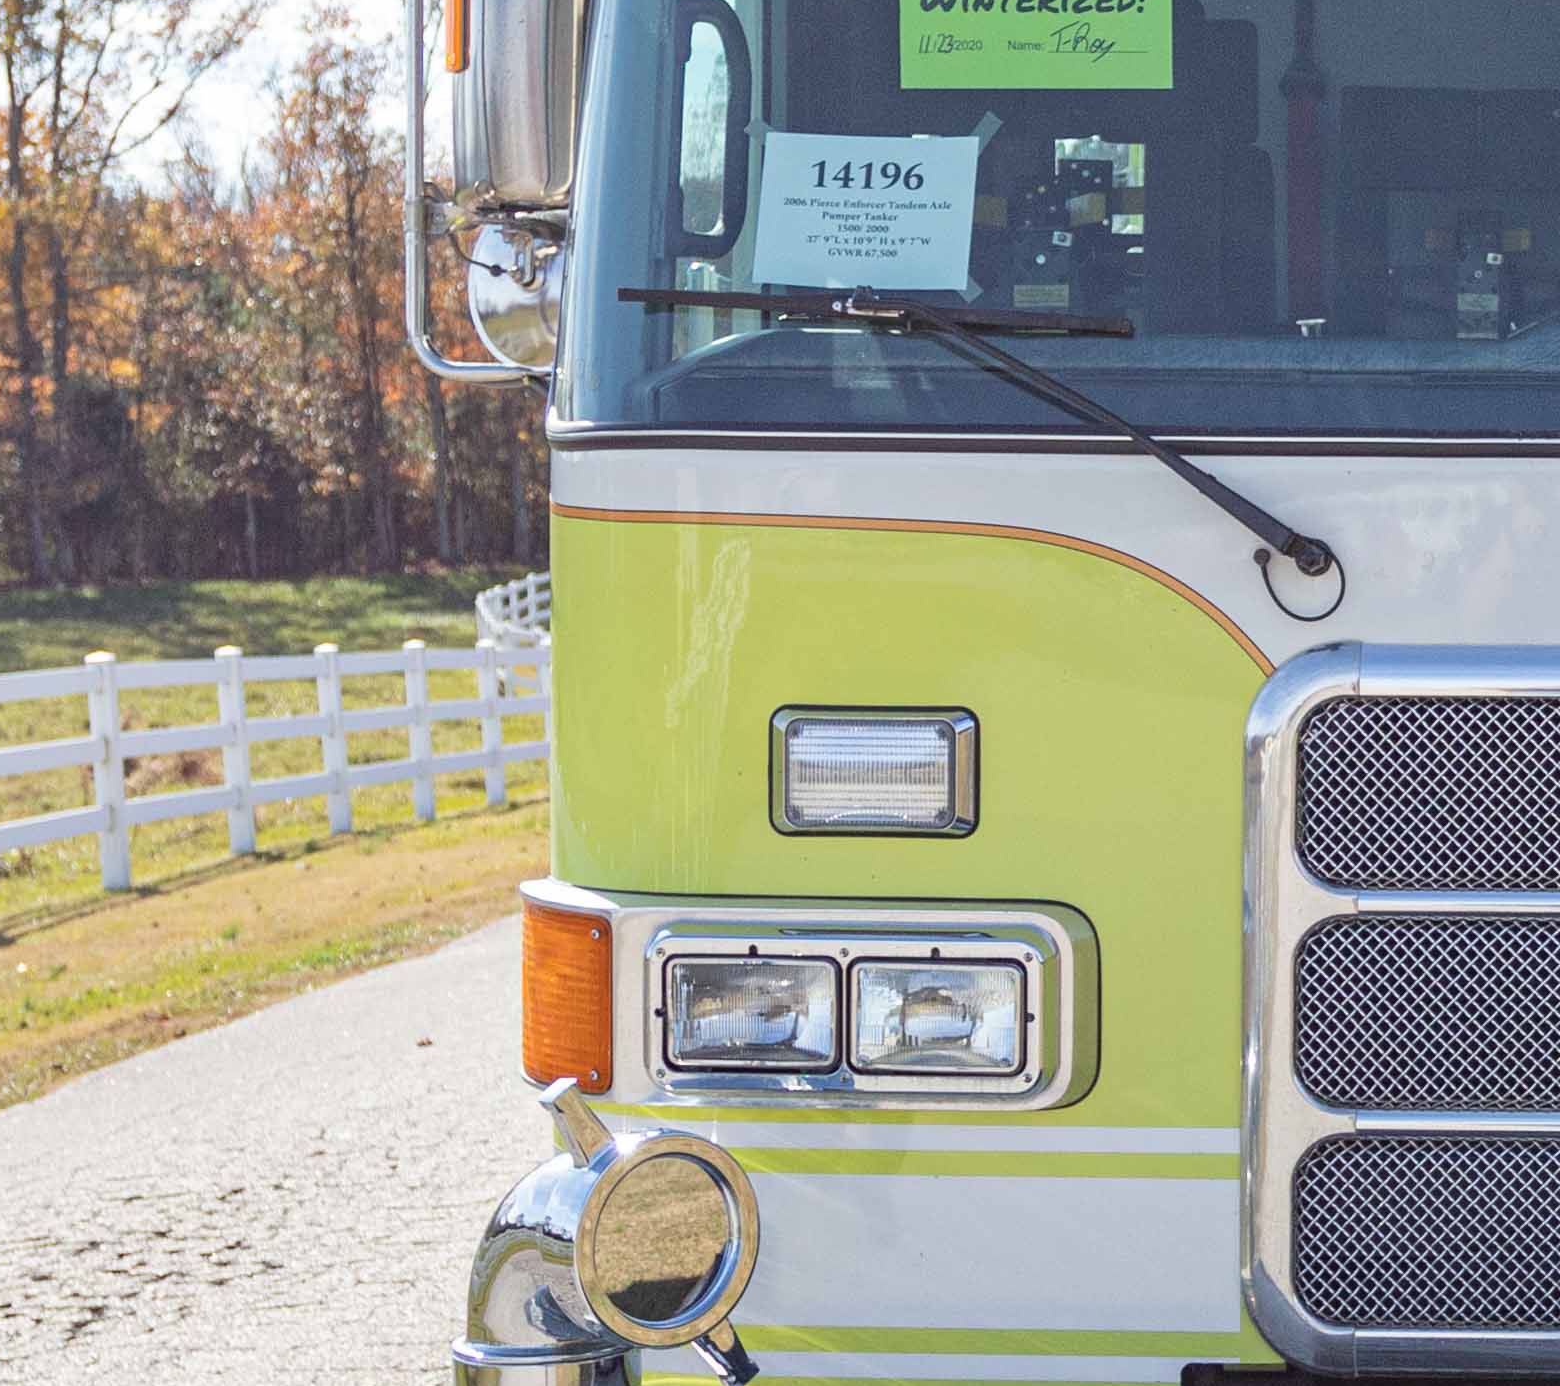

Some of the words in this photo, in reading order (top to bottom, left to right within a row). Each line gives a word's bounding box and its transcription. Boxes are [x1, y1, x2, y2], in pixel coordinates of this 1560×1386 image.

[811, 159, 925, 191] 14196
[783, 197, 807, 207] 2006
[810, 198, 840, 208] Pierce
[843, 199, 885, 209] Enforcer
[889, 200, 927, 210] Tandem
[930, 200, 952, 210] Axle
[822, 211, 861, 222] Pumper
[865, 212, 898, 222] Tanker
[828, 248, 862, 257] GVWR
